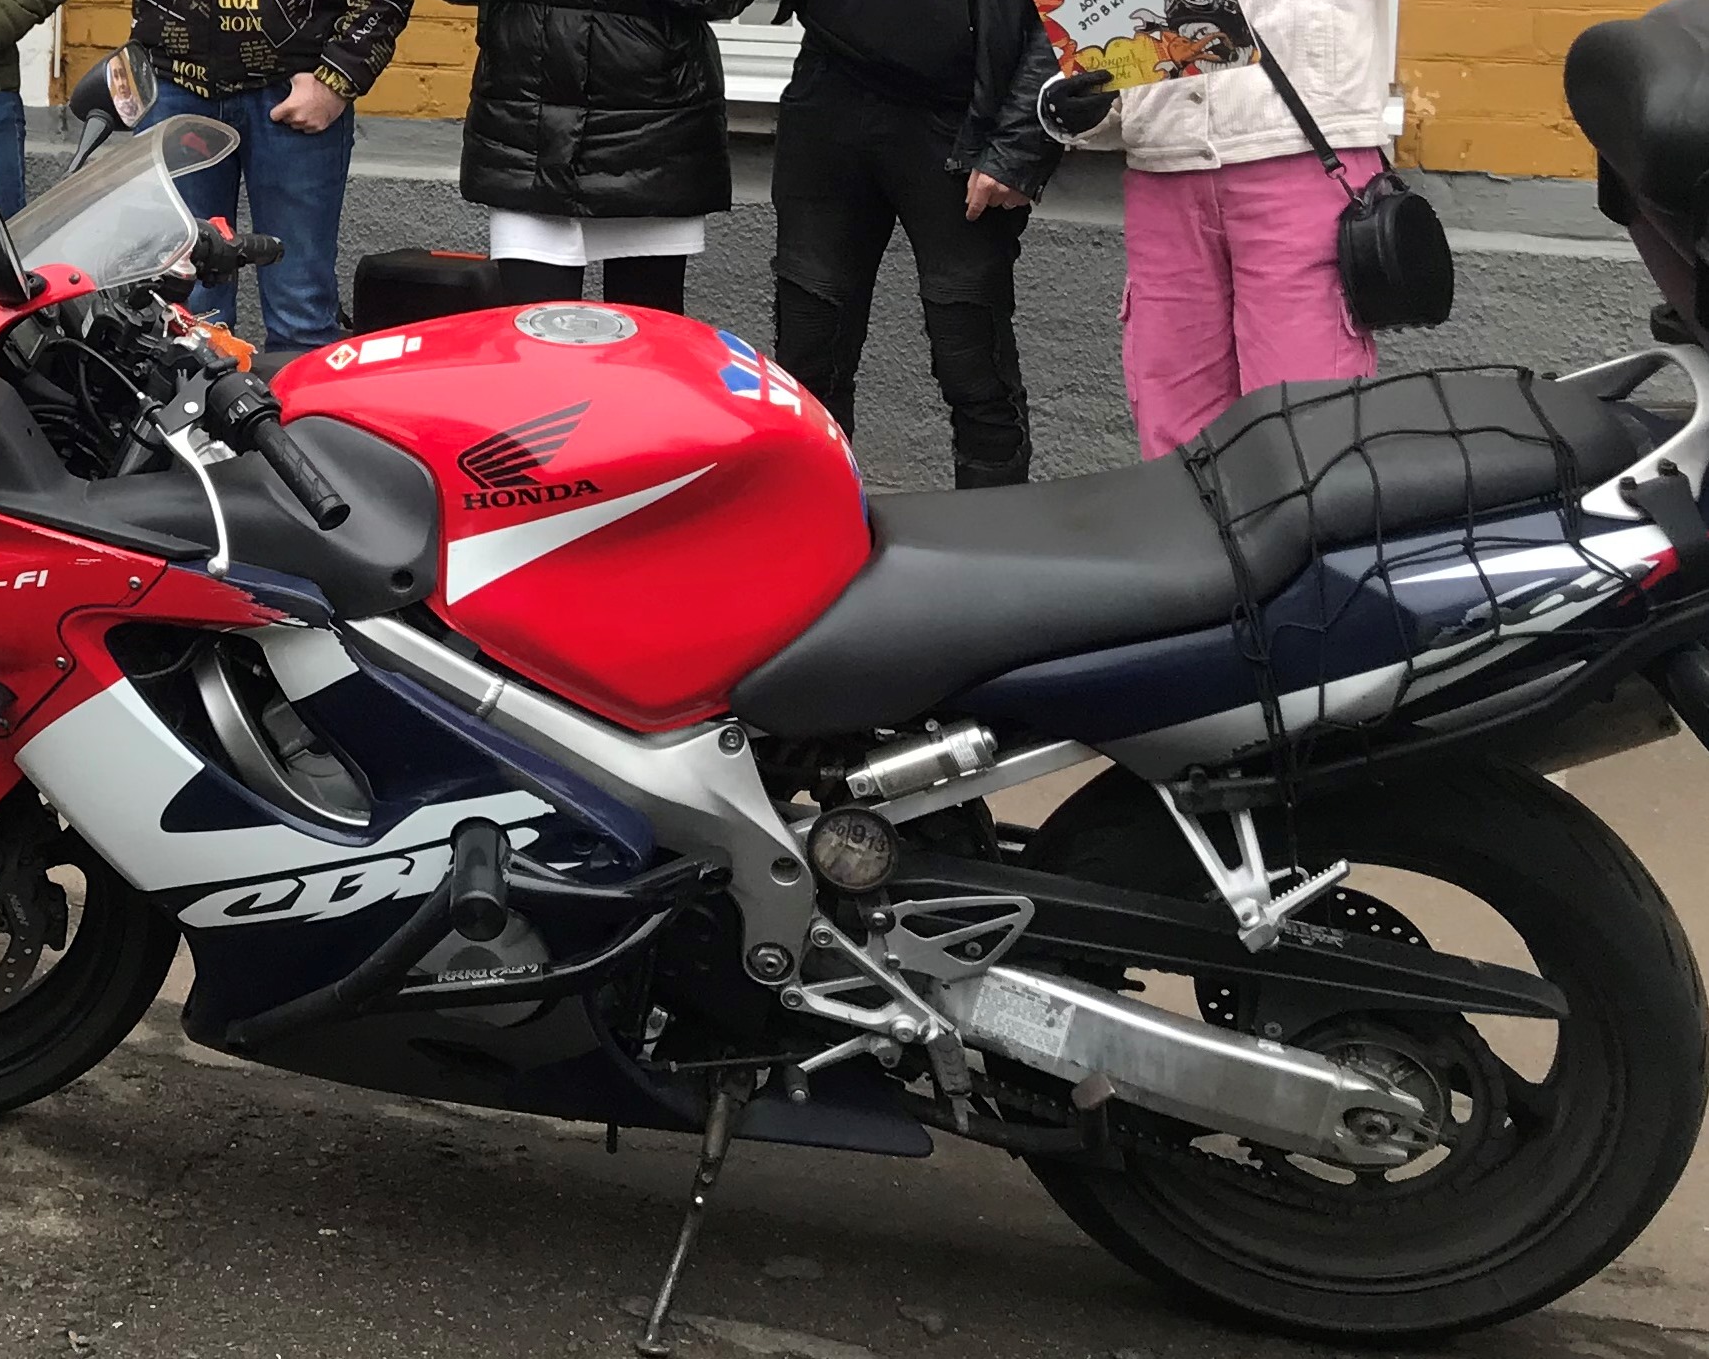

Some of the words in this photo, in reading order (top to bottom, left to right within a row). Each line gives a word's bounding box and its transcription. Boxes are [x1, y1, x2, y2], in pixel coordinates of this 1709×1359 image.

[1077, 11, 1101, 31] ЭТО
[1102, 4, 1112, 17] В
[463, 479, 603, 511] HONDA
[13, 569, 49, 591] FI
